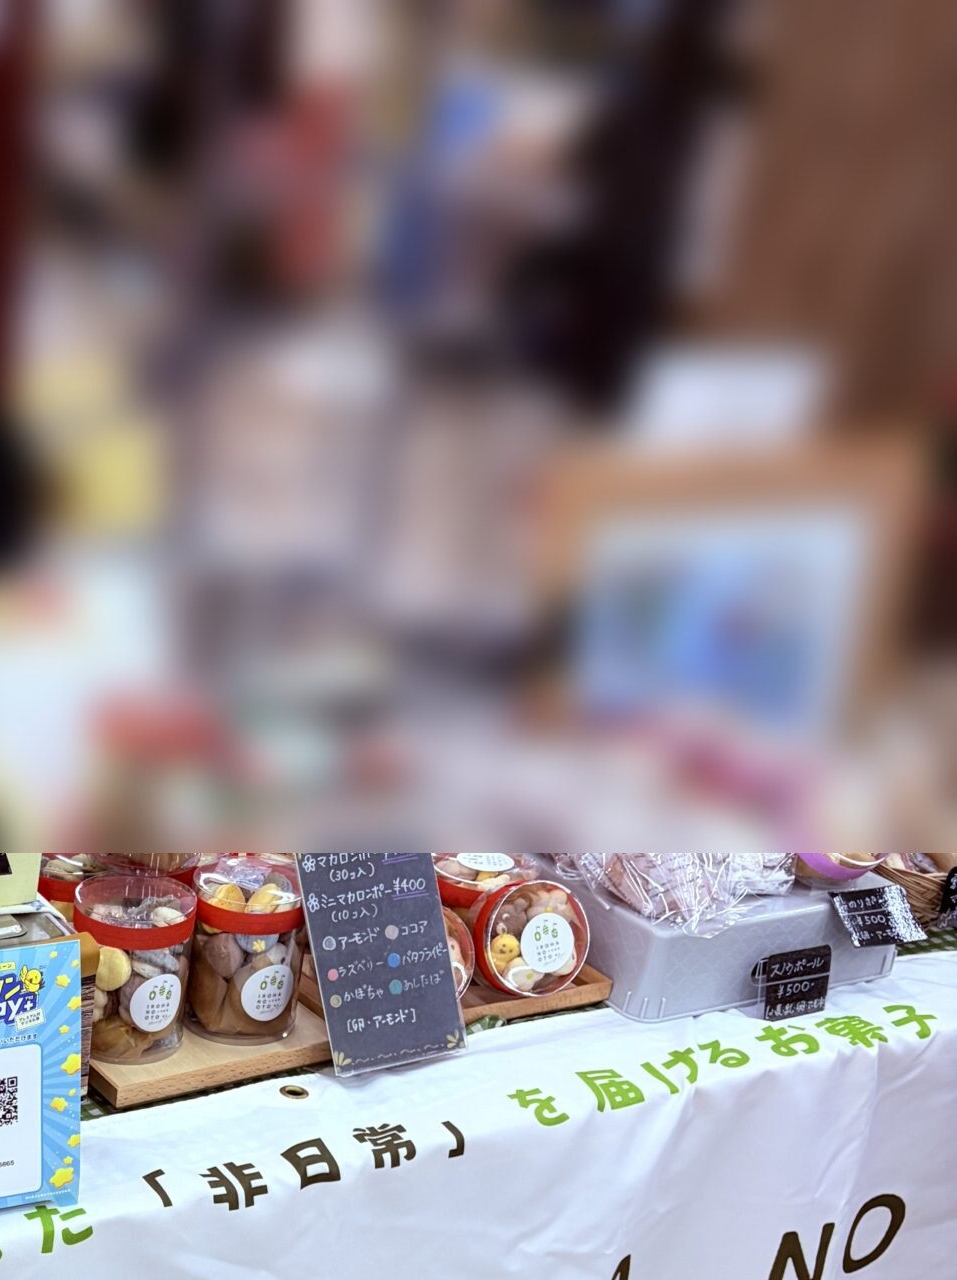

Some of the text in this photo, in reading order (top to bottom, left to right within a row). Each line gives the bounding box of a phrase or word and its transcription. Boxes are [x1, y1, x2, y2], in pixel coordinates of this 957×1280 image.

[393, 877, 426, 895] ¥400
[338, 921, 428, 950] アーモンド ココア
[338, 960, 384, 977] ラズベリー
[343, 970, 444, 1003] かぼちゃ あしたば
